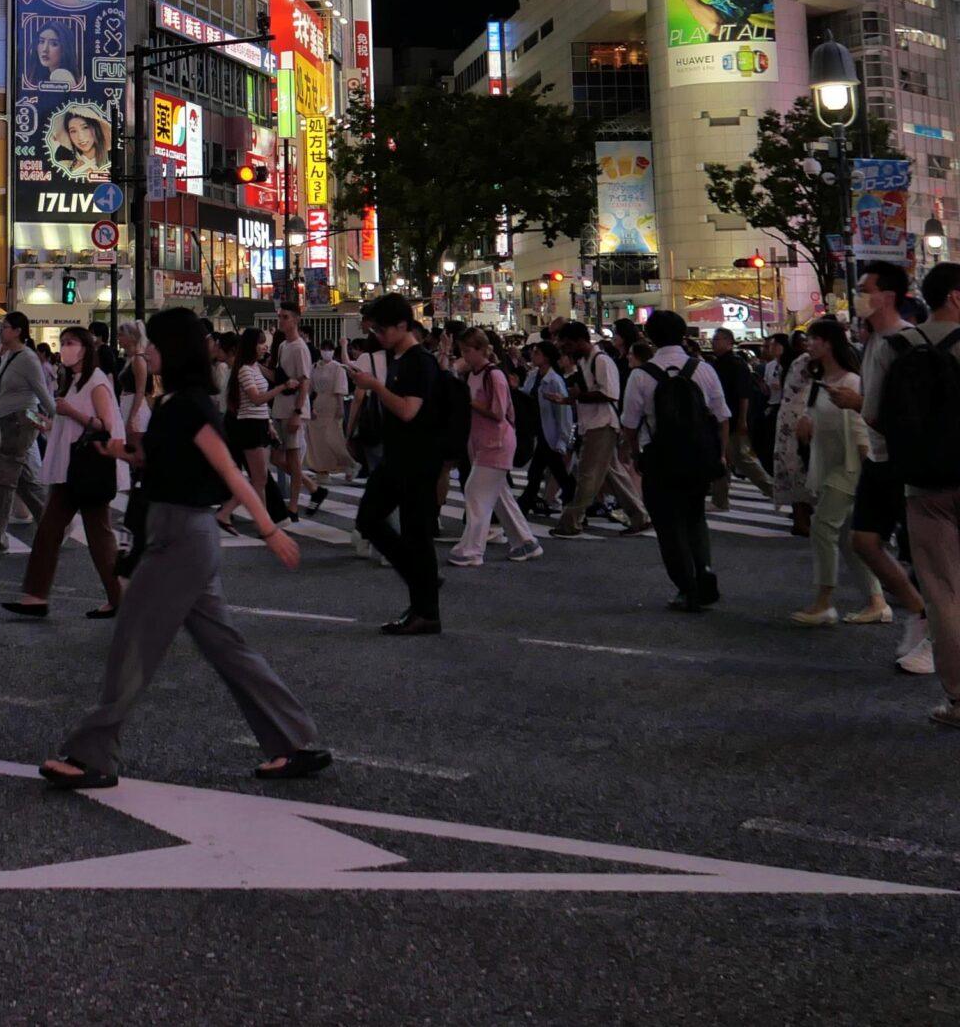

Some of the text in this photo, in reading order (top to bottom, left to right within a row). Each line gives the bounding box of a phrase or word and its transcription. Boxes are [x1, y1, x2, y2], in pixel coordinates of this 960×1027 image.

[669, 24, 774, 45] PLAY IT ALL
[263, 51, 277, 73] 4F
[675, 55, 715, 66] HUAWEI
[156, 102, 170, 141] 薬
[20, 160, 43, 171] ICHI
[308, 119, 324, 202] 処方せん 3F
[20, 170, 52, 182] NANA
[238, 218, 270, 249] LUSH
